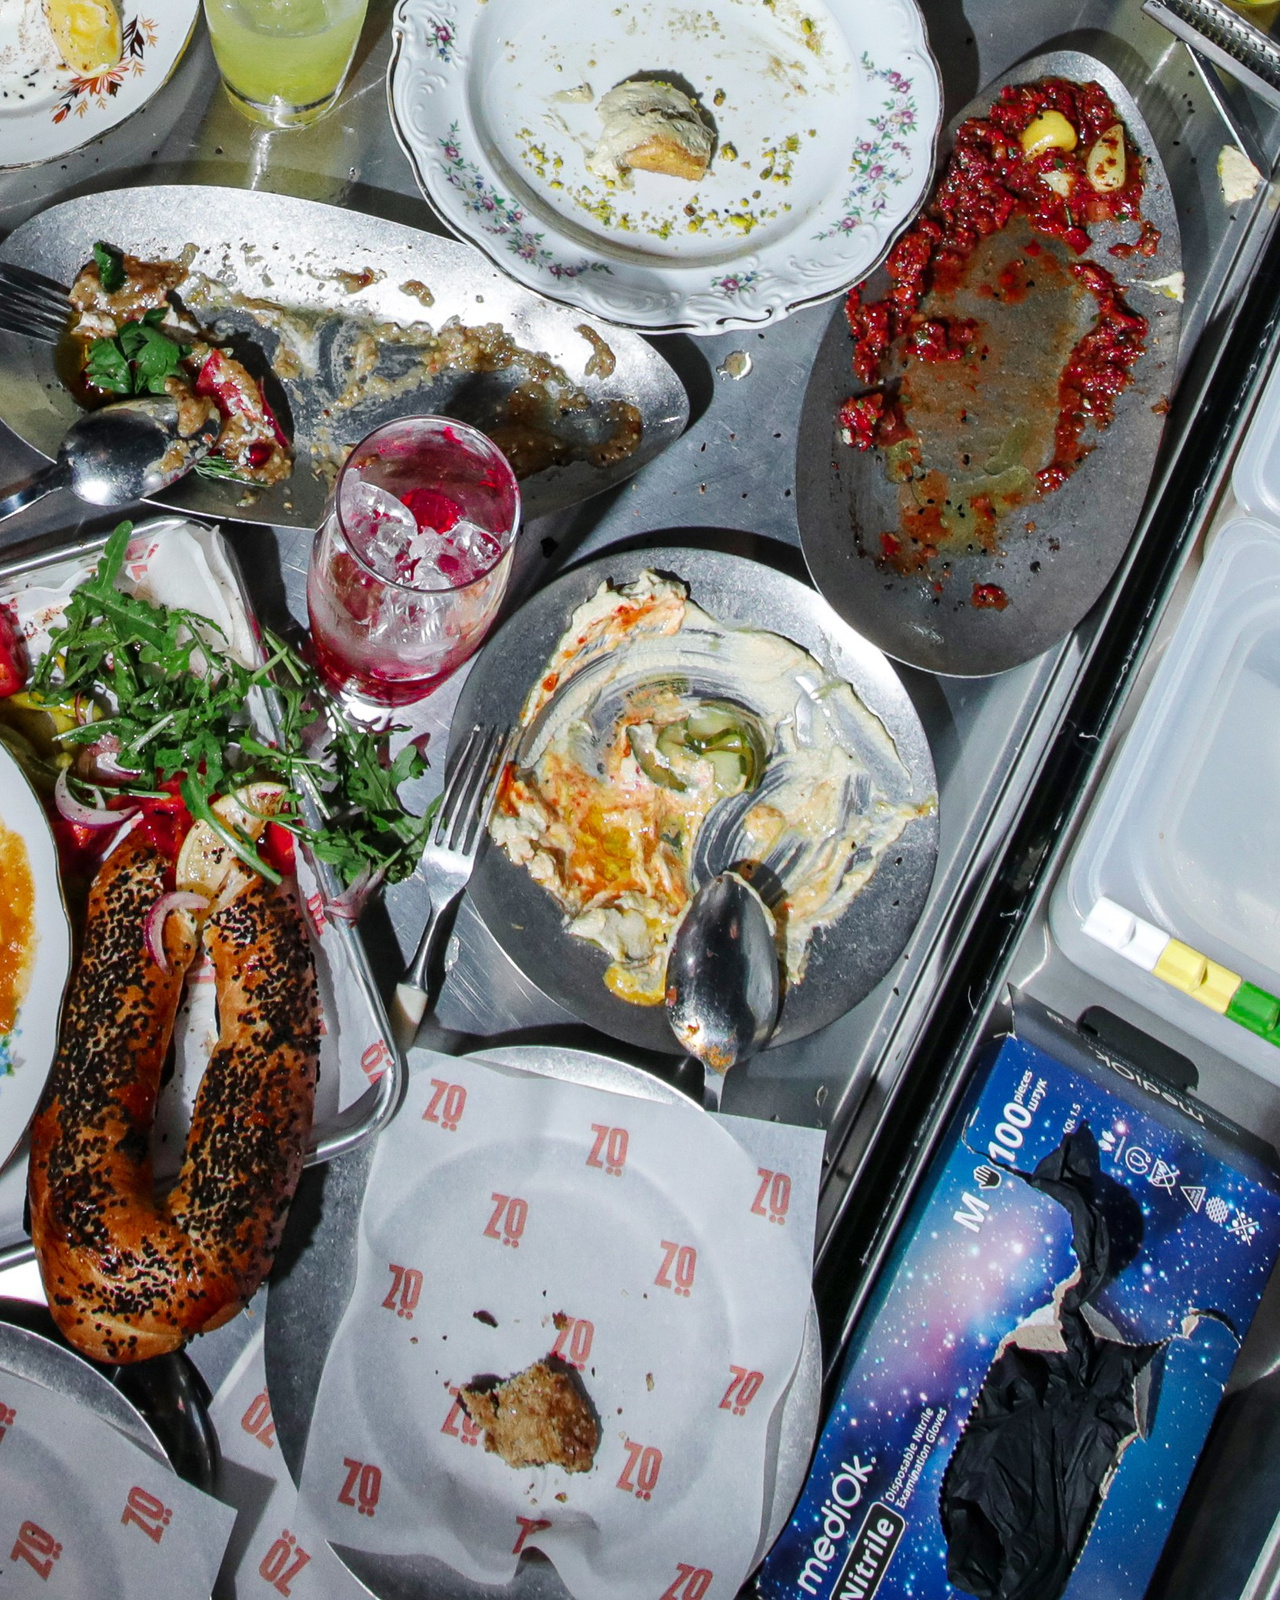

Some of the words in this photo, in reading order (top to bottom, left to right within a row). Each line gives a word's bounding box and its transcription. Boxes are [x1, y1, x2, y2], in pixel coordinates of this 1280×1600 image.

[1013, 1069, 1033, 1104] pieces
[953, 1191, 990, 1233] M
[988, 1102, 1032, 1162] 100
[885, 1442, 918, 1503] Disposable
[912, 1407, 934, 1440] Nitrile
[895, 1443, 931, 1510] Examination
[926, 1407, 948, 1444] Gloves
[839, 1518, 894, 1600] Nitrile
